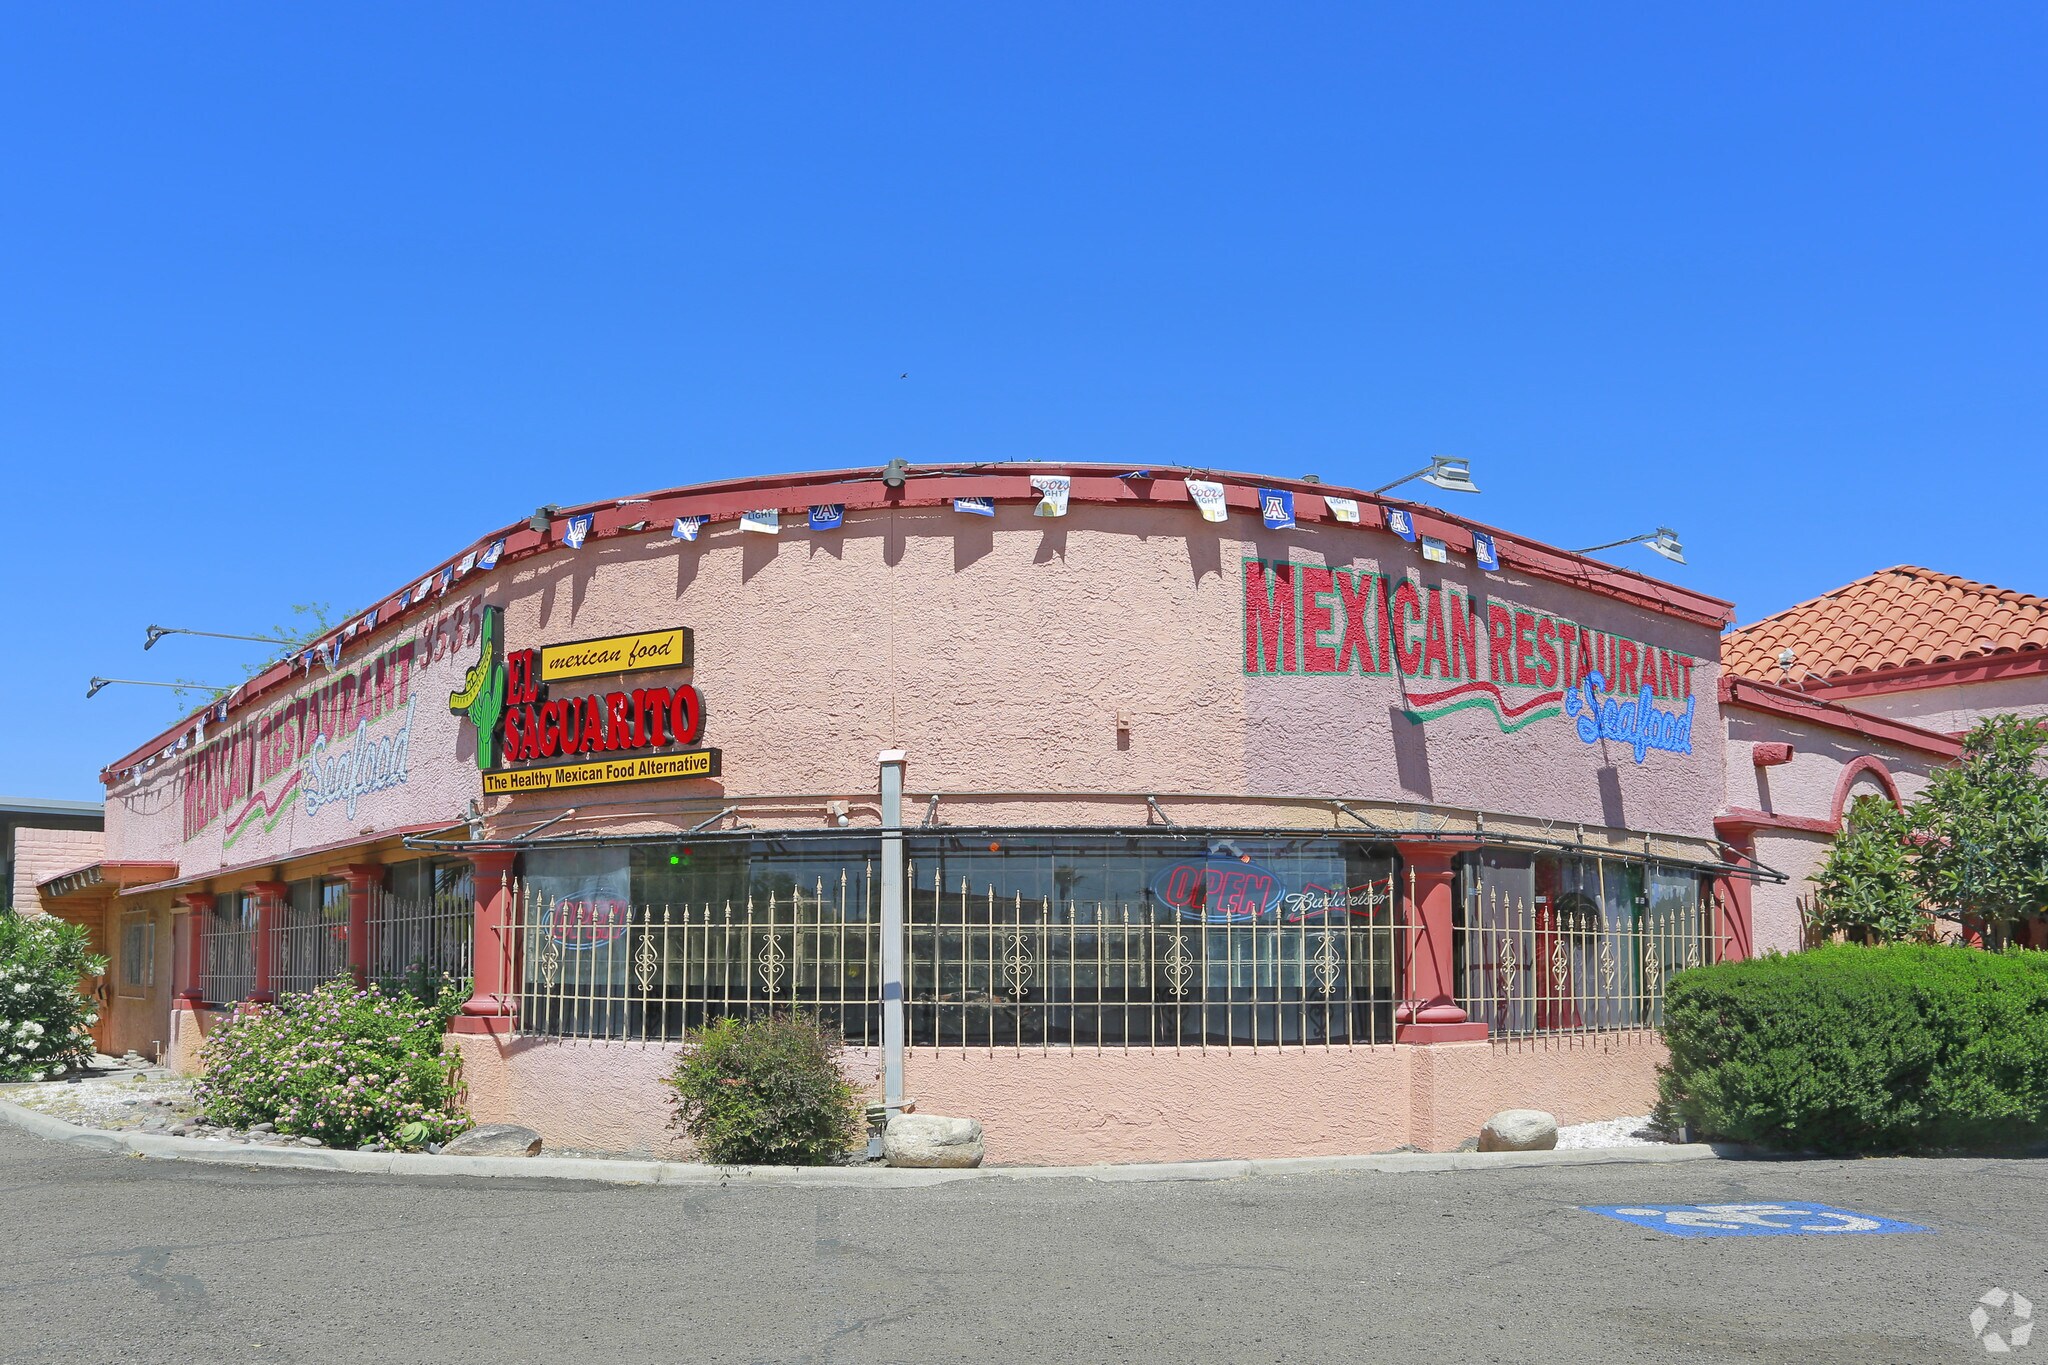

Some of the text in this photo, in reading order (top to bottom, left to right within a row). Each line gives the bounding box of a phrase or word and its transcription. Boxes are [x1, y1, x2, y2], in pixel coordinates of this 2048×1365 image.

[1032, 478, 1070, 490] Coors
[1188, 484, 1224, 498] Coors
[1263, 497, 1290, 521] A
[420, 595, 481, 669] 3535
[550, 636, 674, 669] mexican food
[1243, 558, 1695, 700] MEXICAN RESTAURANT
[507, 648, 538, 706] EL
[183, 637, 416, 841] MEXICAN RESTAURANT
[504, 685, 699, 761] SAGUARITO
[1576, 670, 1695, 764] Seafood
[304, 692, 416, 821] Seafood
[487, 756, 708, 790] The Healthy Mexican Food Alternative
[1166, 866, 1272, 916] OPEN
[1285, 892, 1390, 912] Budweiser
[552, 900, 626, 939] OPEN
